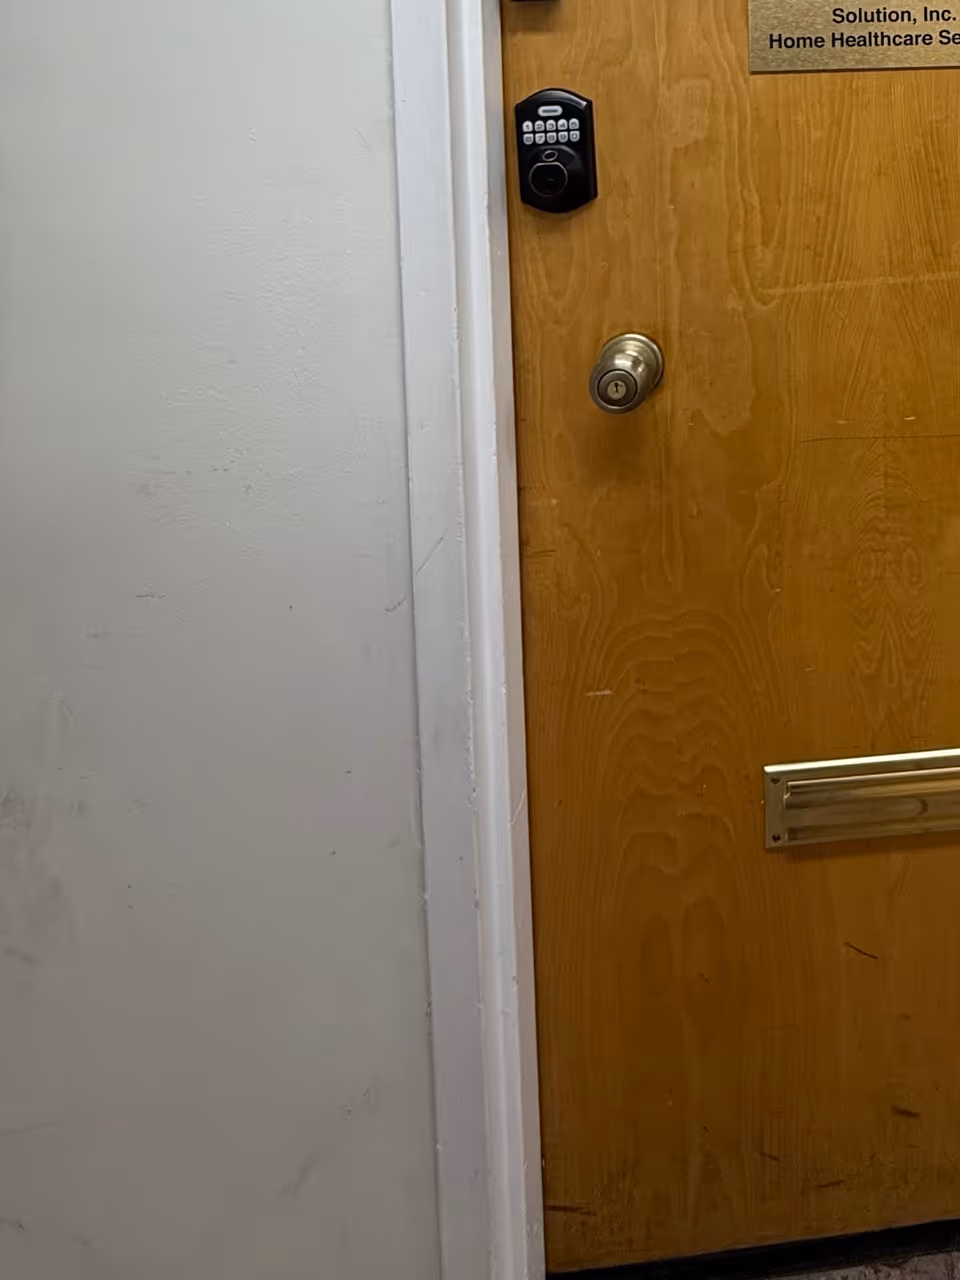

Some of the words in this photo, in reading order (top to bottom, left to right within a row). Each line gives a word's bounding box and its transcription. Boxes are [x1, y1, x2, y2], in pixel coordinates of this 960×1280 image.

[832, 7, 917, 25] Solution,
[924, 6, 957, 22] Inc.
[769, 32, 826, 49] Home
[831, 30, 933, 48] Healthcare
